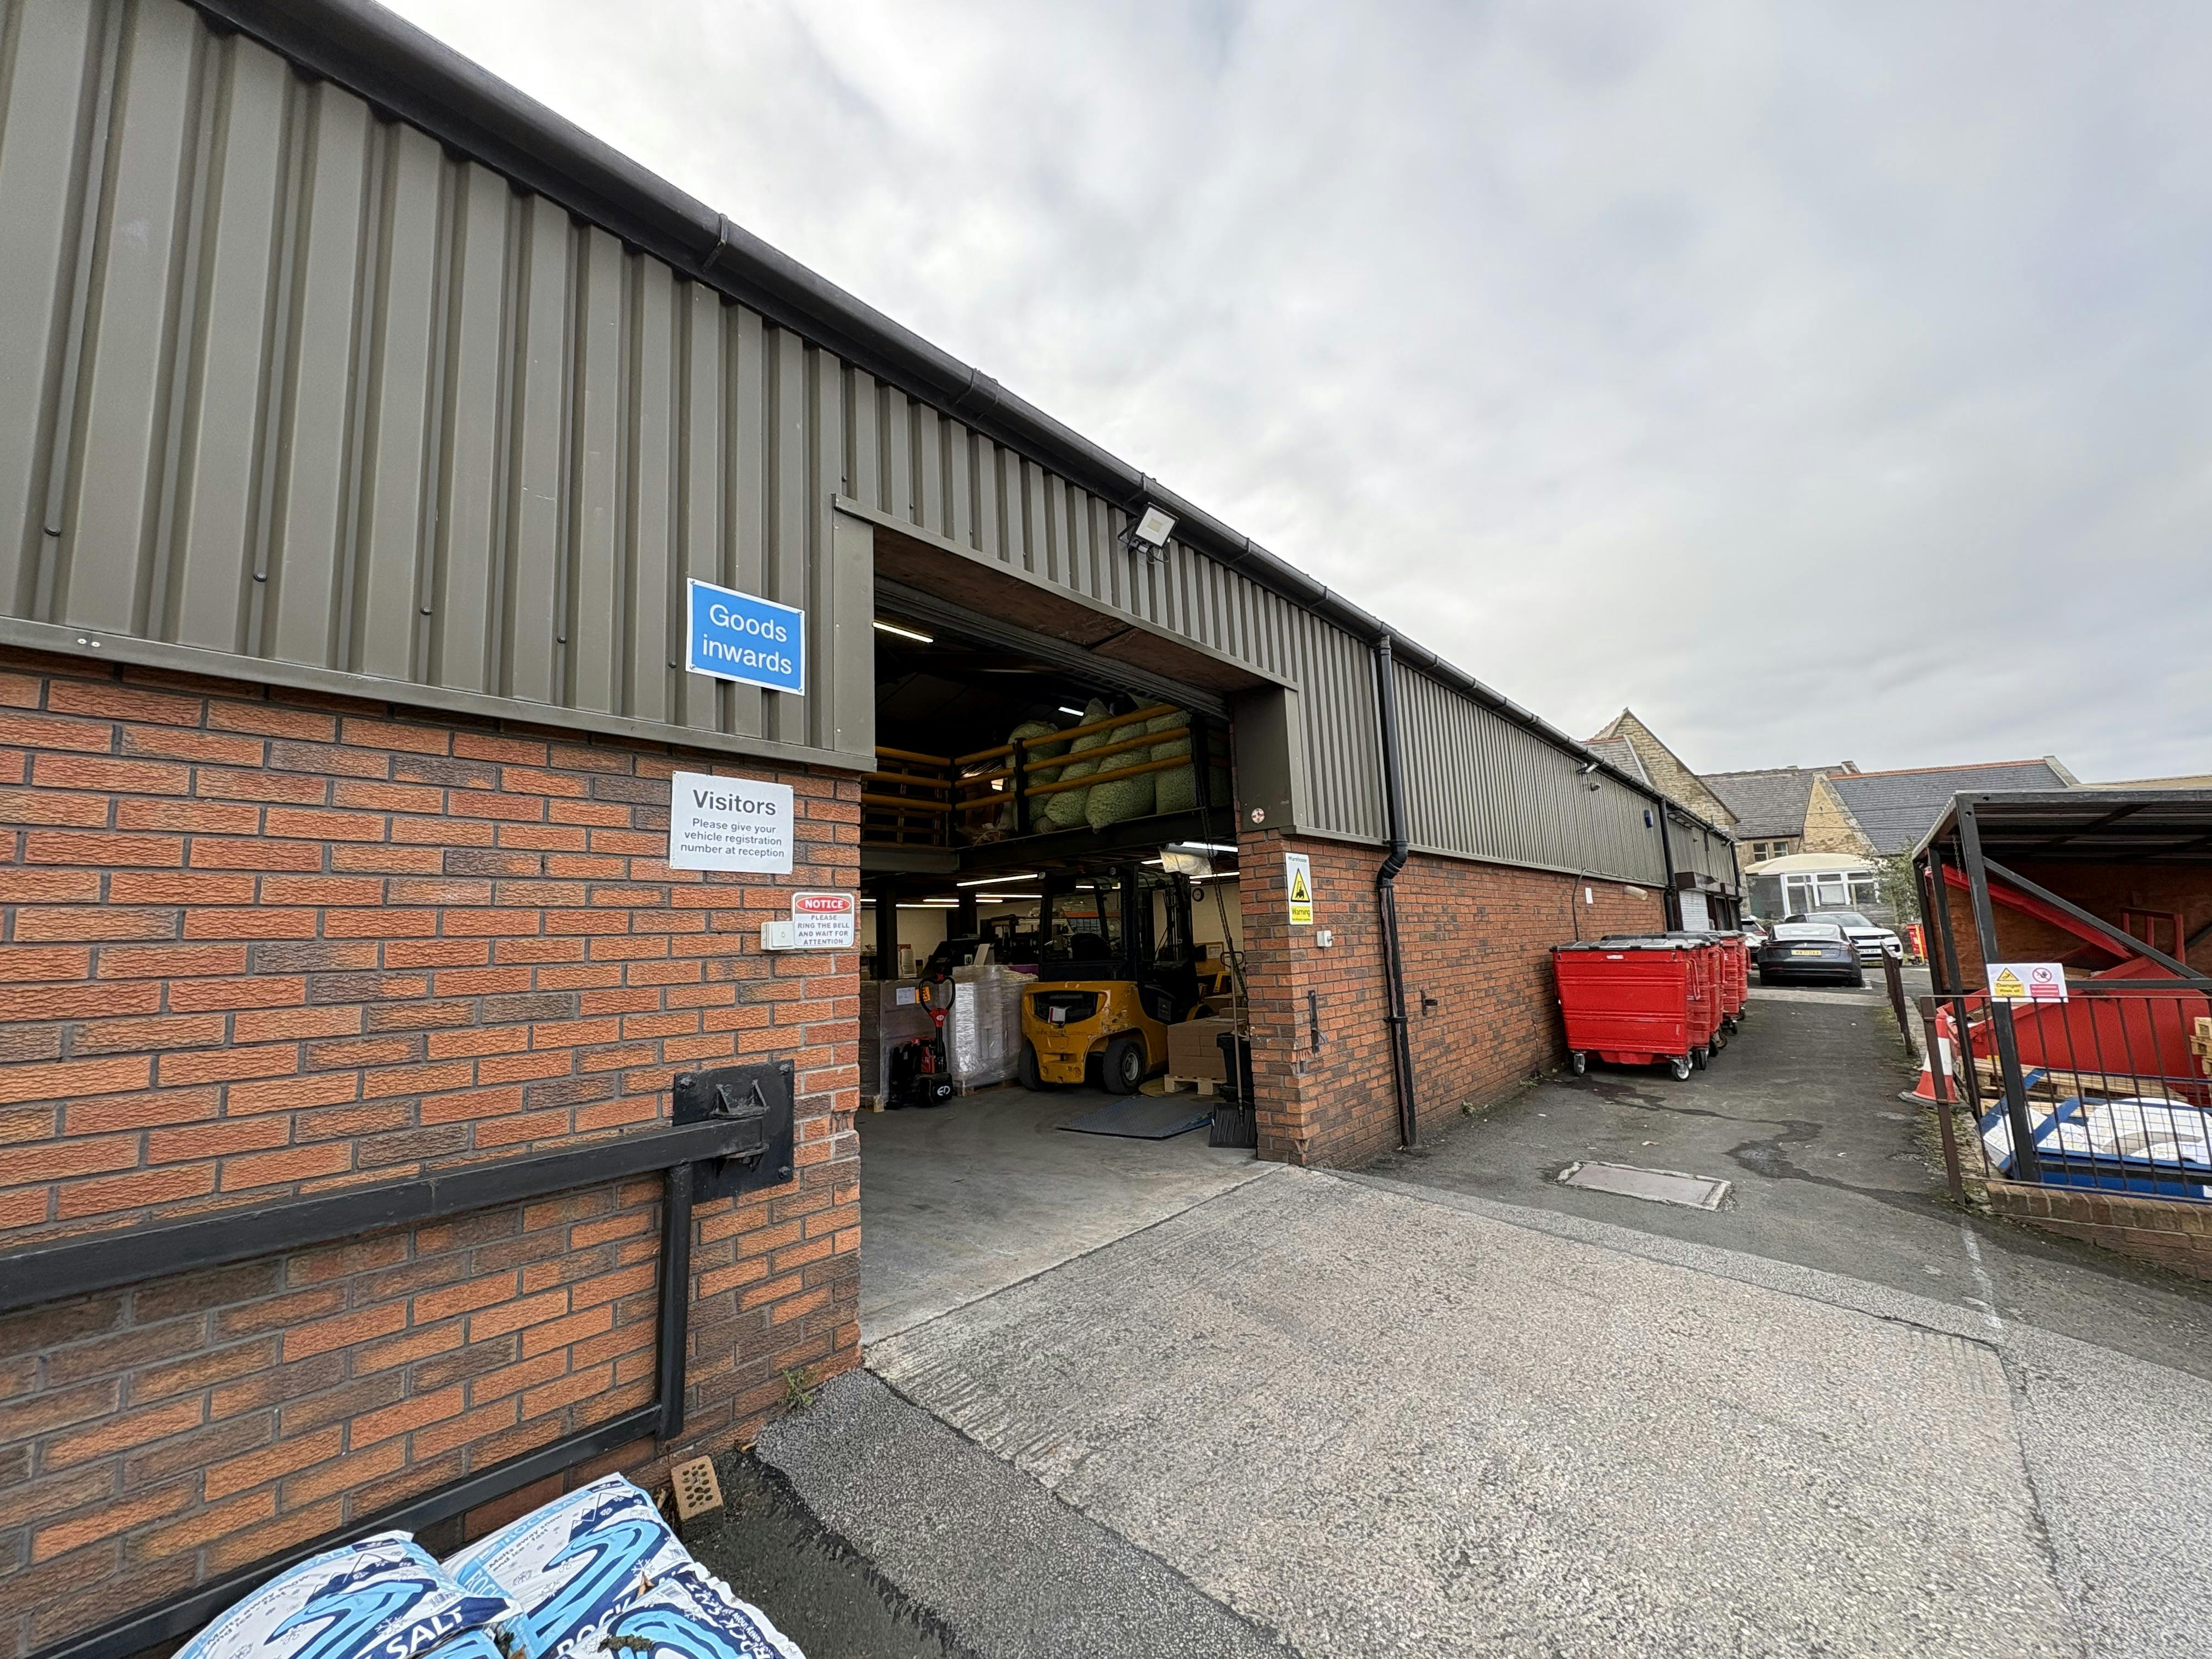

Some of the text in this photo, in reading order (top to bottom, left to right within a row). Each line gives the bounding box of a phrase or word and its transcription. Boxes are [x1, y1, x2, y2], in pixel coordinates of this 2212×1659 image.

[709, 604, 787, 642] Goods
[702, 634, 792, 675] inwards
[693, 789, 776, 816] Visitors
[685, 831, 782, 846] vehicle registration
[692, 818, 776, 834] Please give your
[681, 843, 785, 859] number at reception
[805, 900, 844, 909] NOTICE
[1291, 907, 1311, 917] Warning
[489, 1514, 563, 1568] Melts away snow
[207, 1575, 310, 1645] Melts away snow
[386, 1606, 463, 1659] SALT
